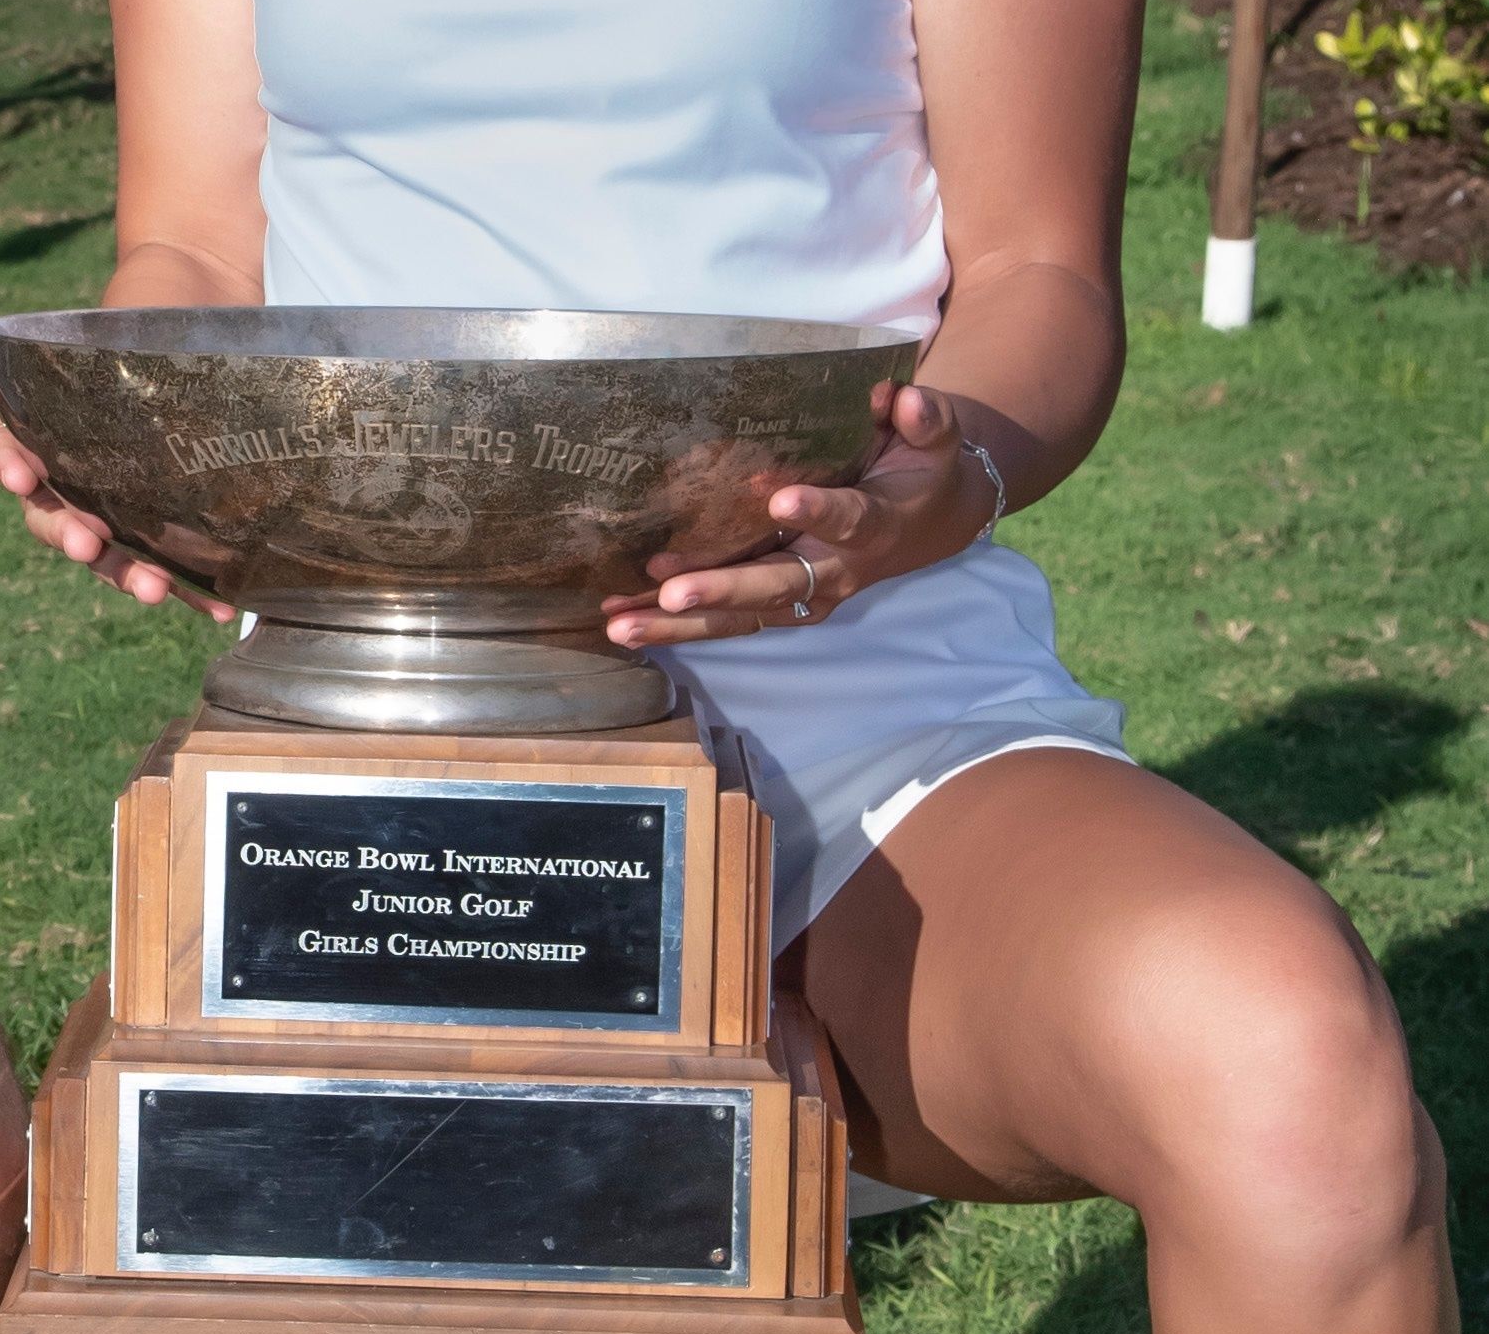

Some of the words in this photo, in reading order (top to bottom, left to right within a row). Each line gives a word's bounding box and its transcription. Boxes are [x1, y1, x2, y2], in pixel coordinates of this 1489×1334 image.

[335, 410, 516, 463] JEWELERS
[532, 424, 645, 485] TROPHY
[240, 842, 349, 868] ORANGE
[358, 847, 434, 871] BOWL
[442, 850, 650, 879] INTERNATIONAL
[352, 890, 452, 915] JUNIOR
[460, 893, 533, 918] GOLF
[299, 930, 378, 955] GIRLS
[388, 933, 586, 962] CHAMPIONSHIP
